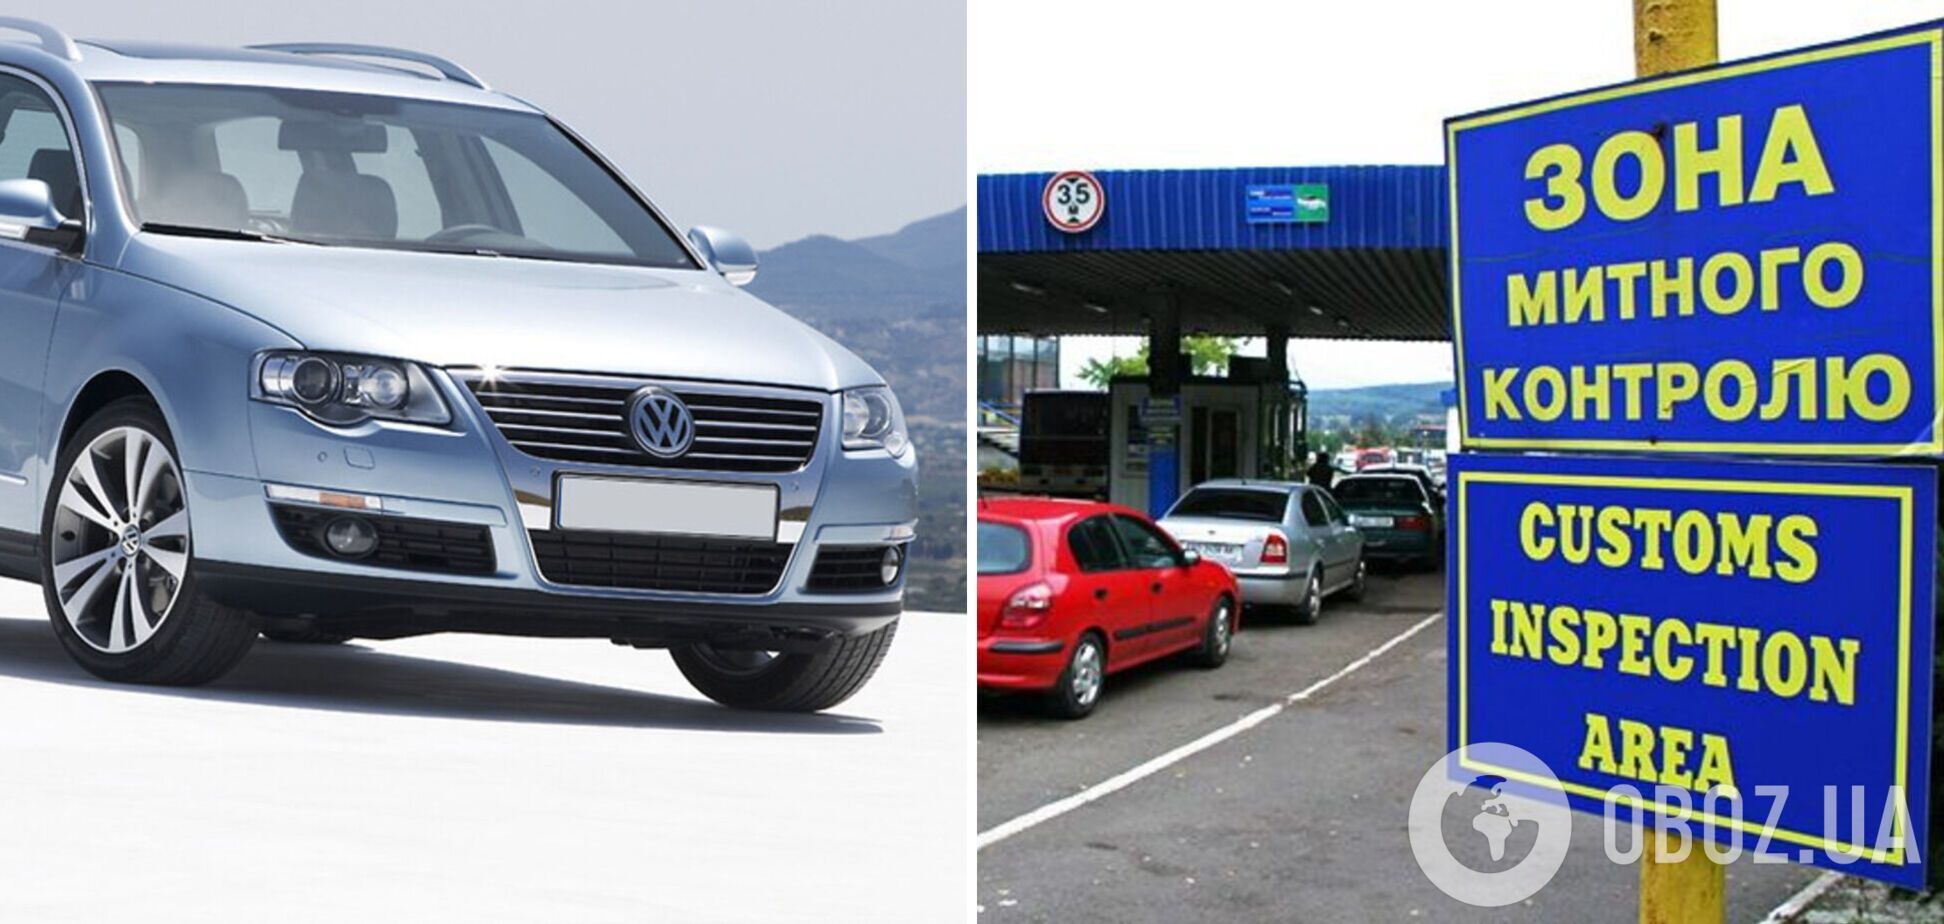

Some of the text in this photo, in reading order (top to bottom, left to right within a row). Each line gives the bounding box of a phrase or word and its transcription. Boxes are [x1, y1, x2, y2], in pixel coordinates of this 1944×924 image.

[1523, 103, 1835, 231] ЗОНА
[1506, 241, 1864, 327] МИТНОГО
[1482, 352, 1912, 422] КОНТРОЛЮ
[1519, 501, 1820, 584] CUSTOMS
[1490, 599, 1861, 706] INSPECTION
[1577, 712, 1740, 800] AREA
